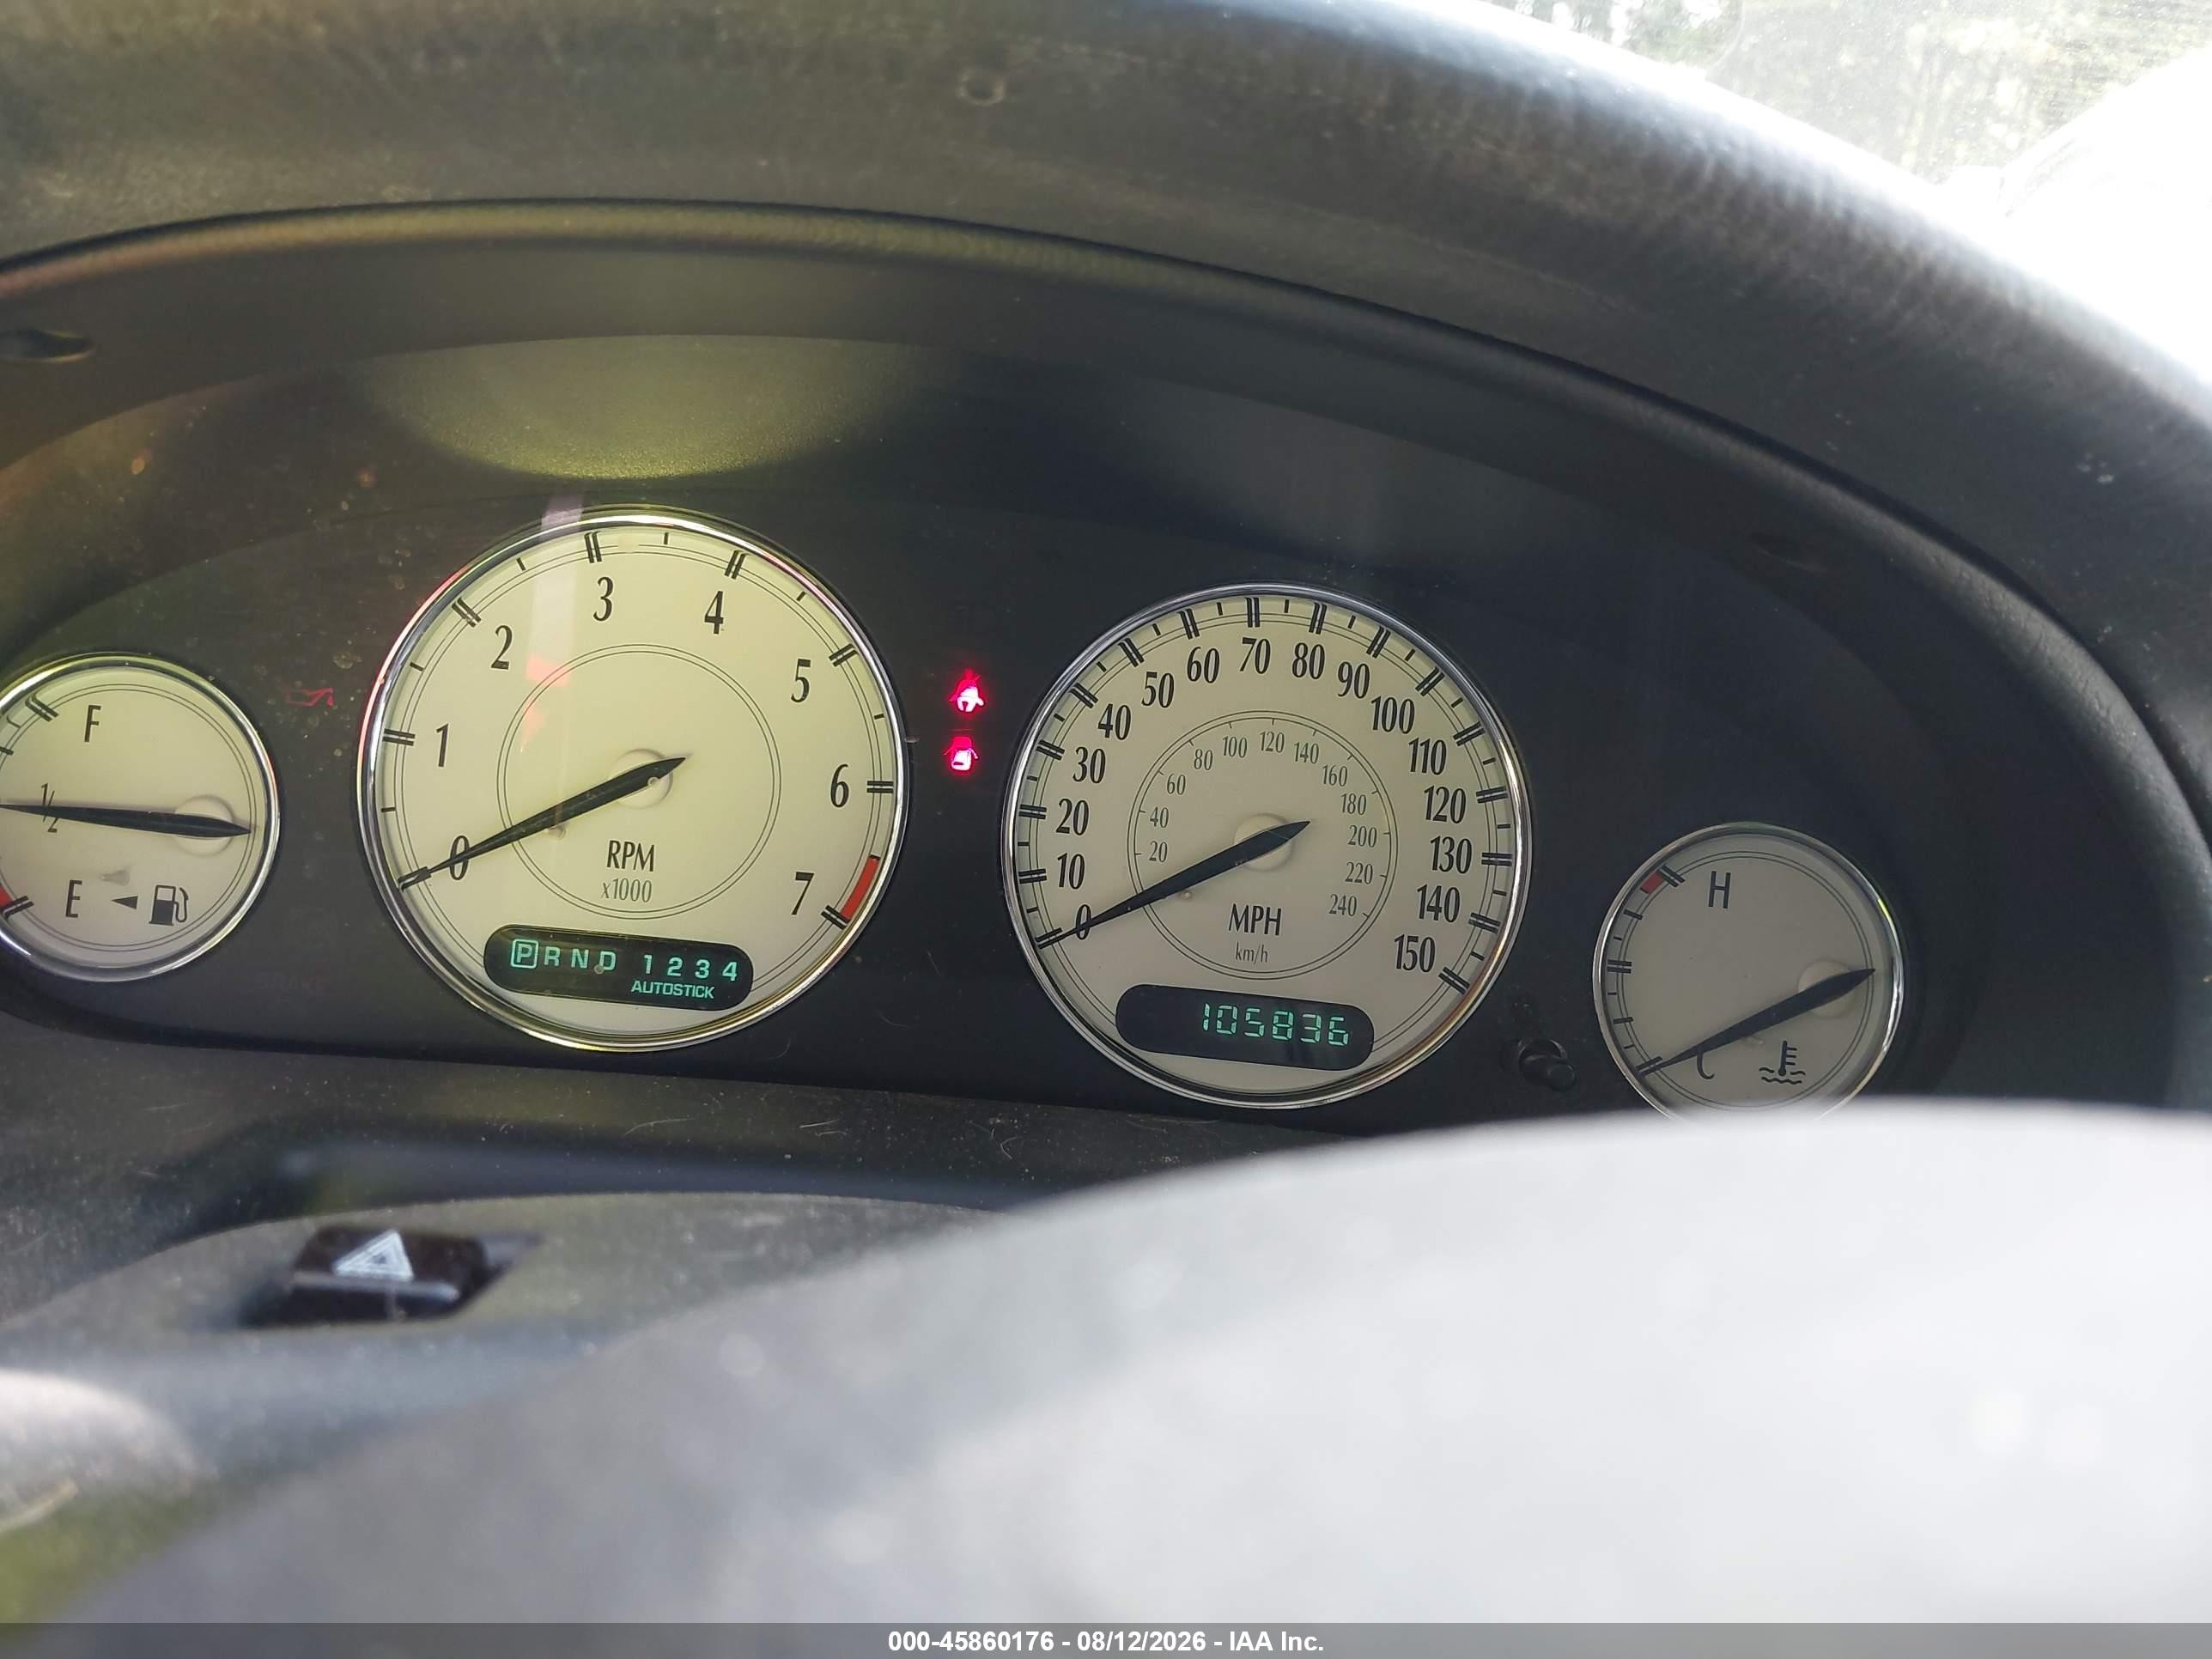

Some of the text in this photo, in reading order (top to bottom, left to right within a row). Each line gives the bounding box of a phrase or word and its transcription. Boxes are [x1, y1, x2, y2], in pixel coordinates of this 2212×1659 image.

[593, 577, 613, 622] 3
[704, 591, 723, 635] 4
[491, 625, 513, 670] 2
[1187, 647, 1220, 684] 60
[1240, 637, 1271, 674] 70
[1291, 643, 1325, 679] 80
[791, 659, 811, 702] 5
[1141, 672, 1175, 708] 50
[1338, 661, 1370, 698] 90
[84, 705, 100, 742] F
[1097, 703, 1132, 740] 40
[1371, 696, 1415, 734] 100
[436, 724, 448, 767] 1
[1194, 749, 1212, 770] 80
[1223, 736, 1247, 758] 100
[1260, 731, 1285, 753] 120
[1294, 742, 1319, 763] 140
[1408, 738, 1447, 775] 110
[1073, 747, 1106, 783] 30
[1322, 765, 1347, 787] 160
[830, 763, 849, 808] 6
[1167, 774, 1186, 795] 60
[1056, 799, 1089, 836] 20
[1149, 807, 1169, 829] 40
[1341, 793, 1366, 815] 180
[1424, 786, 1466, 823] 120
[1149, 841, 1168, 863] 20
[1347, 825, 1377, 848] 200
[1430, 836, 1472, 874] 130
[450, 836, 470, 880] 0
[606, 840, 655, 872] RPM
[1057, 853, 1085, 889] 10
[1345, 862, 1373, 884] 220
[66, 880, 82, 918] E
[602, 878, 652, 903] x1000
[791, 872, 815, 915] 7
[1329, 894, 1358, 917] 240
[1417, 884, 1460, 923] 140
[1708, 871, 1730, 908] H
[1076, 904, 1091, 940] 0
[1229, 904, 1282, 935] MPH
[517, 943, 738, 981] P R N D 1 2 3 4
[1236, 945, 1268, 963] km/h
[1395, 934, 1435, 972] 150
[631, 980, 714, 999] AUTOSTICK
[1203, 1002, 1349, 1047] 105836
